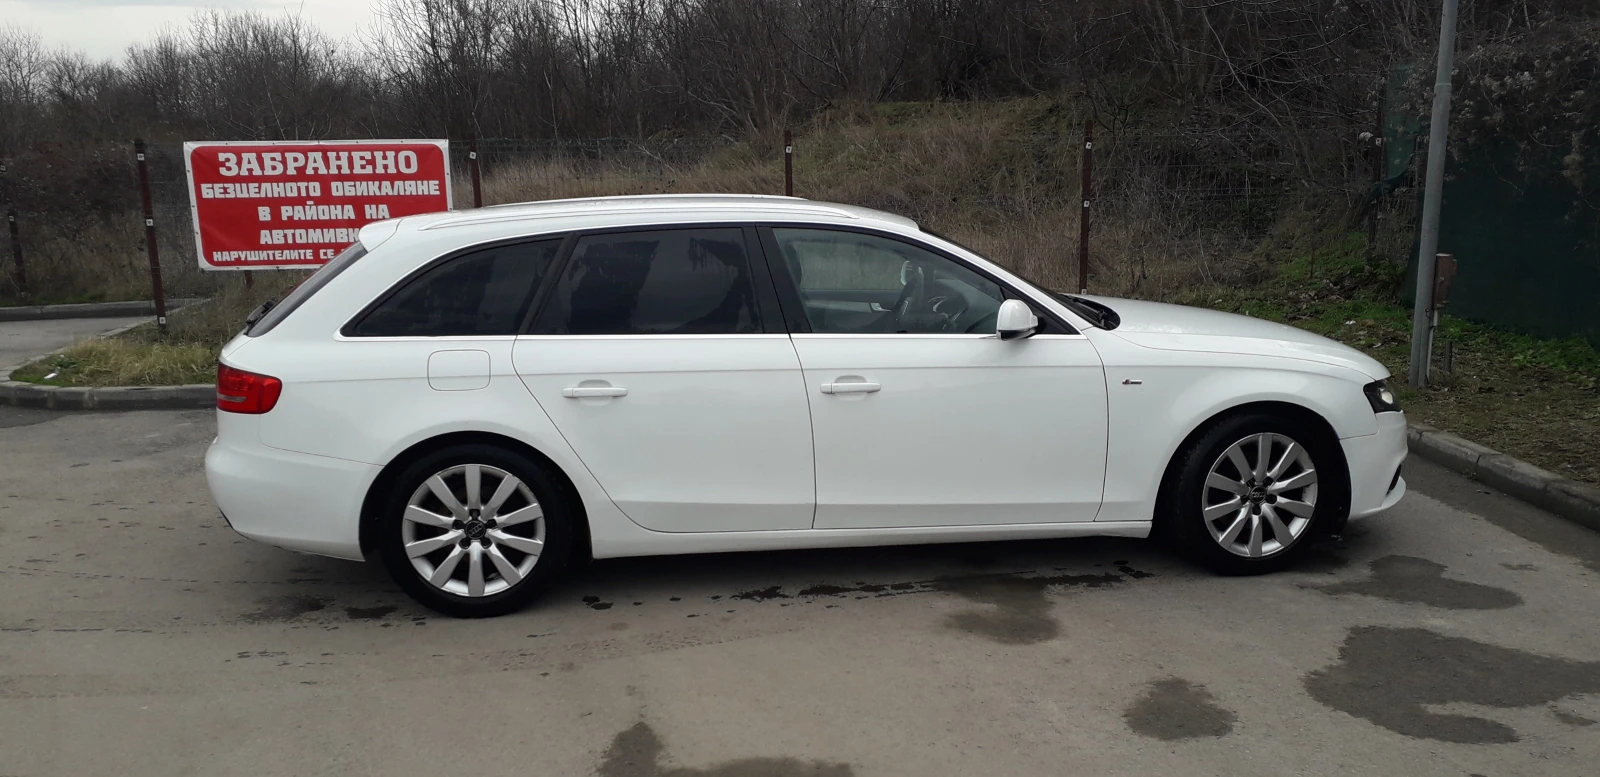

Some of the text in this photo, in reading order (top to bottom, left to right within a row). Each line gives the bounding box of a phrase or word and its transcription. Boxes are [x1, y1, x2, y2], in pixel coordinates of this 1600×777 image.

[218, 150, 418, 177] ЗАБРАНЕНО
[201, 180, 440, 198] БЕЗЦЕЛНОТО ОБИКАЛЯНЕ
[258, 201, 390, 221] В РАЙОНА НА
[260, 228, 360, 244] АВТОМИВК
[212, 249, 334, 261] НАРУШИТЕЛИТЕ СЕ
